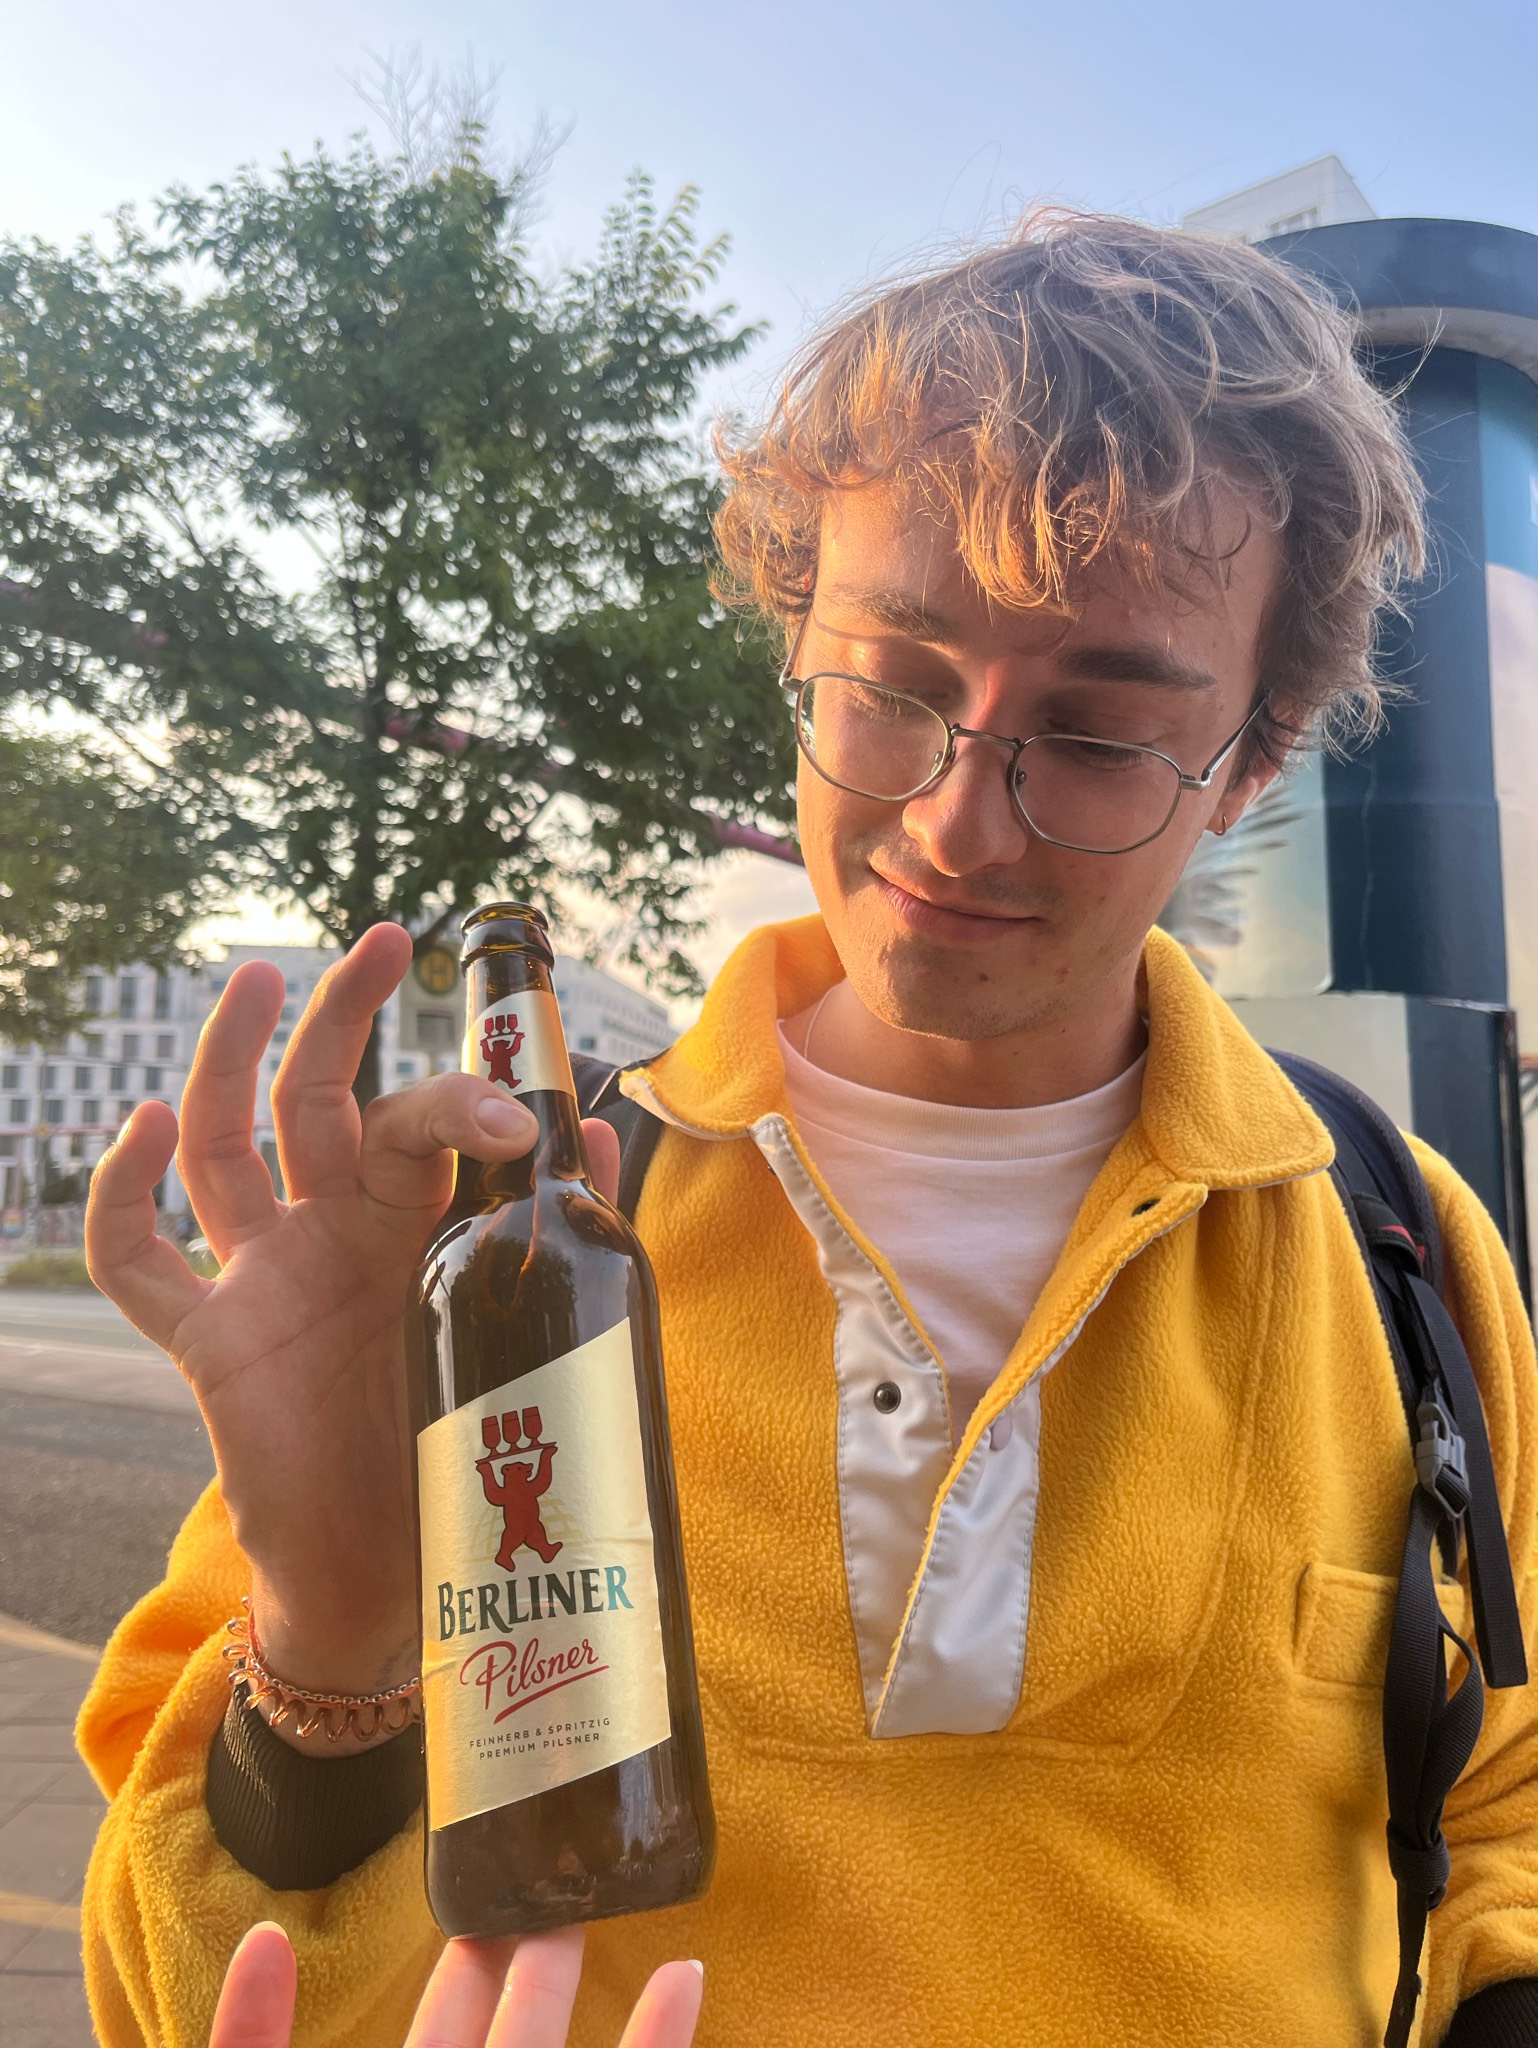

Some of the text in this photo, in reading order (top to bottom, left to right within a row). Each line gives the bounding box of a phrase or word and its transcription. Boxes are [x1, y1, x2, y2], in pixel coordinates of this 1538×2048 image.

[427, 954, 449, 988] H
[438, 1565, 635, 1642] BERLINER
[459, 1637, 599, 1711] Pilsner
[469, 1717, 610, 1748] FEINHERB & SPRITZIG
[479, 1732, 600, 1760] PREMIUM PILSNER
